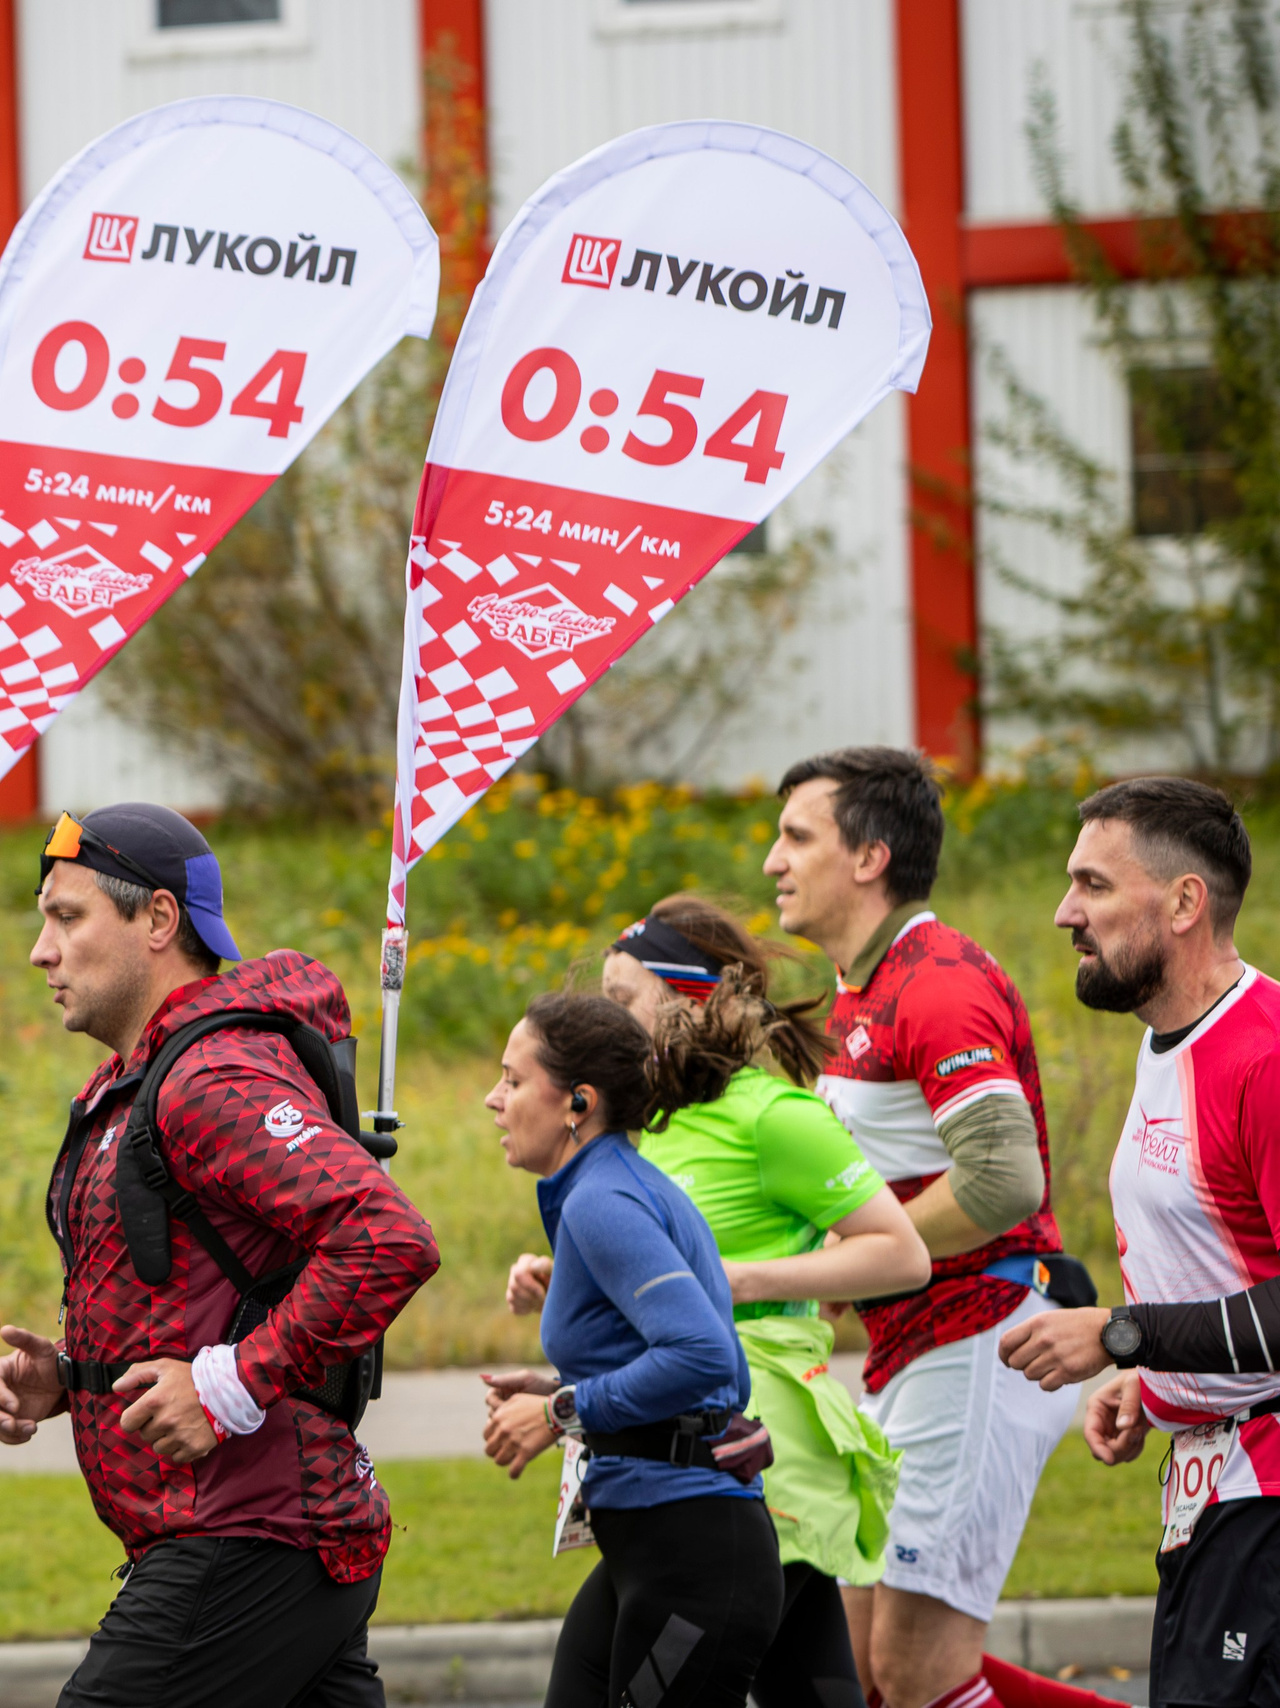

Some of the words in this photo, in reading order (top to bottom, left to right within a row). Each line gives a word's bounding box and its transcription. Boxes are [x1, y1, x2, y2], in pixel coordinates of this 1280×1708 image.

[141, 225, 357, 286] ЛУКОЙЛ
[621, 250, 847, 330] ЛУКОЙЛ
[32, 321, 308, 438] 0:54
[500, 347, 789, 485] 0:54
[25, 468, 89, 498] 5:24
[484, 500, 553, 534] 5:24
[33, 580, 122, 609] ЗАБЕГ
[491, 618, 582, 652] ЗАБЕГ
[937, 1048, 993, 1077] WINLINE
[272, 1104, 302, 1126] 35
